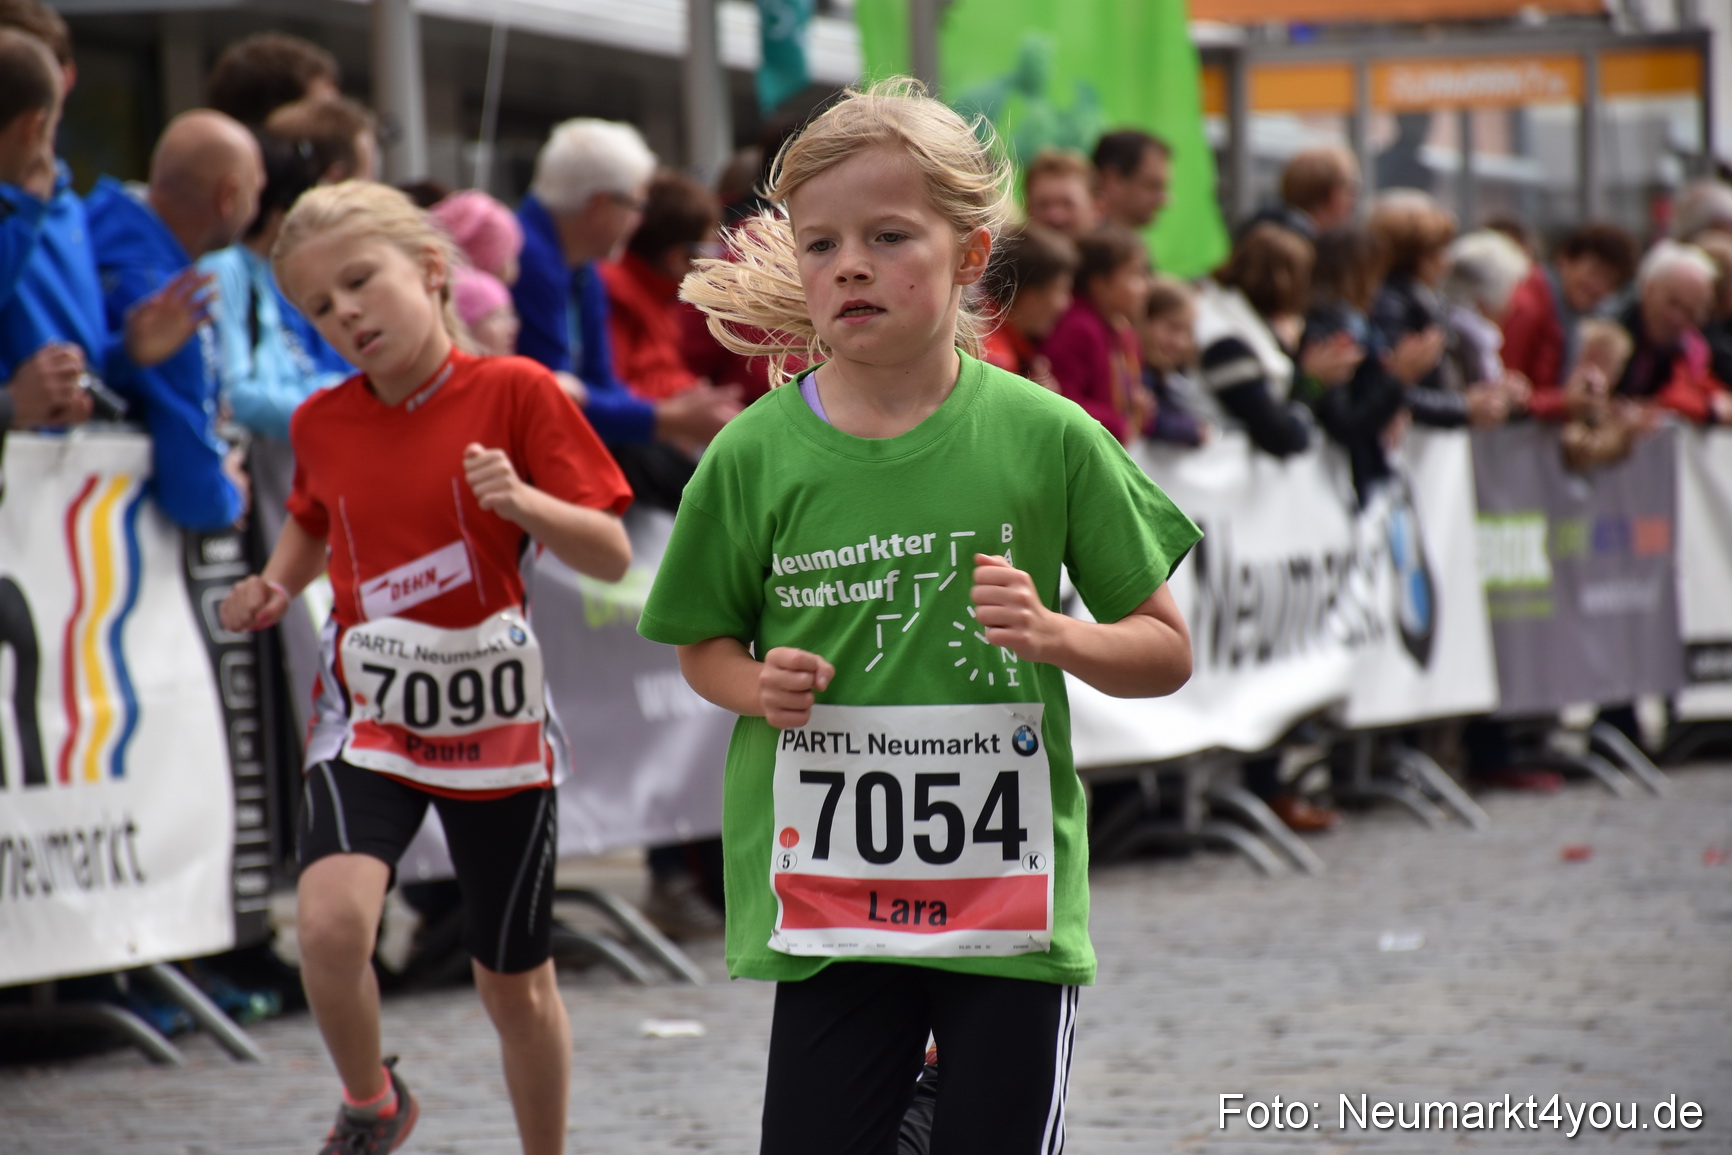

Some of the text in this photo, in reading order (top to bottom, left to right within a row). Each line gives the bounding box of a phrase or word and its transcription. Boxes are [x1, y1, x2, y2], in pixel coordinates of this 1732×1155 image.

[390, 567, 438, 602] DEHN
[349, 631, 508, 666] PARTL Neumarkt
[362, 659, 525, 730] 7090
[407, 735, 481, 763] Paula
[782, 729, 1001, 756] PARTL Neumarkt
[800, 770, 1027, 865] 7054
[781, 853, 791, 870] 5
[1029, 854, 1039, 870] K
[868, 891, 948, 926] Lara
